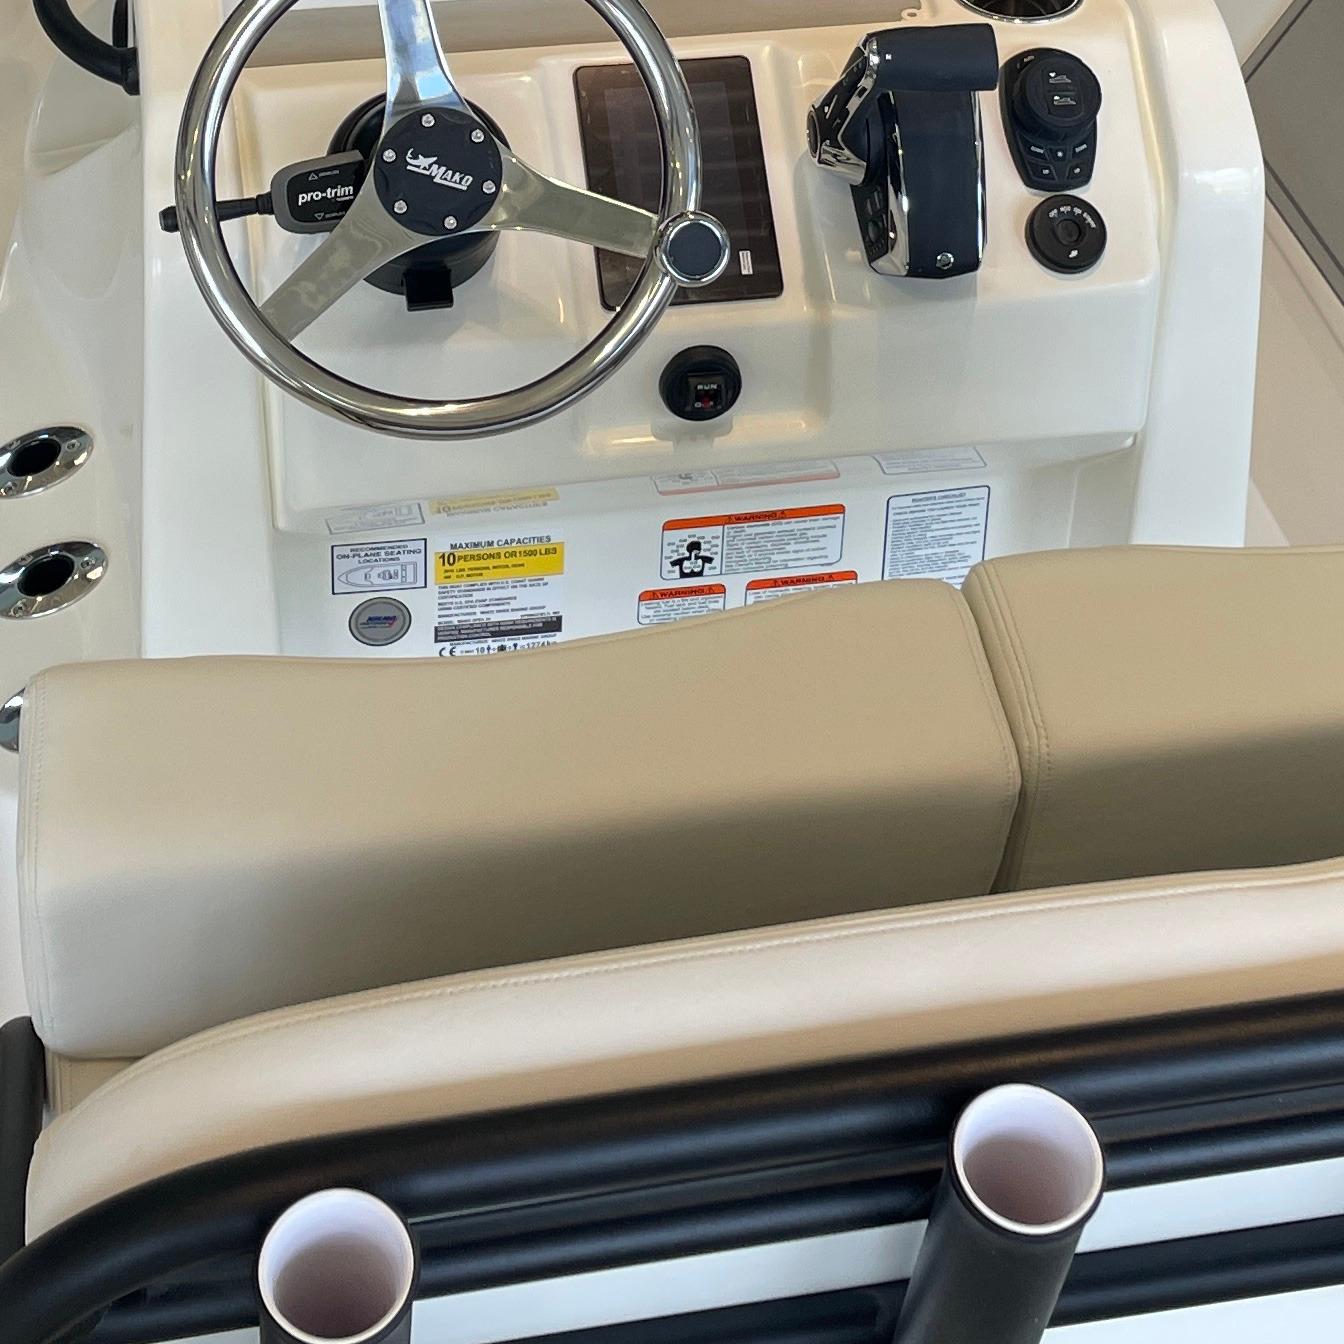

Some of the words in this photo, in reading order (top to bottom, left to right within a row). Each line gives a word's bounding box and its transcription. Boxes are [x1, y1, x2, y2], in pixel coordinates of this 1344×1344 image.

[426, 163, 474, 191] MAKO
[298, 184, 354, 206] pro-trim
[734, 512, 778, 522] WARNING
[350, 544, 408, 553] RECOMMENDED
[450, 539, 494, 550] MAXIMUM
[496, 535, 551, 547] CAPACITIES
[336, 551, 382, 560] ON-PLANE
[384, 548, 422, 556] SEATING
[439, 552, 456, 567] 10
[457, 550, 502, 563] PERSONS
[503, 549, 518, 559] OR
[518, 547, 538, 557] 1500
[539, 547, 557, 556] LBS
[780, 576, 825, 586] WARNING
[659, 588, 705, 598] WARNING
